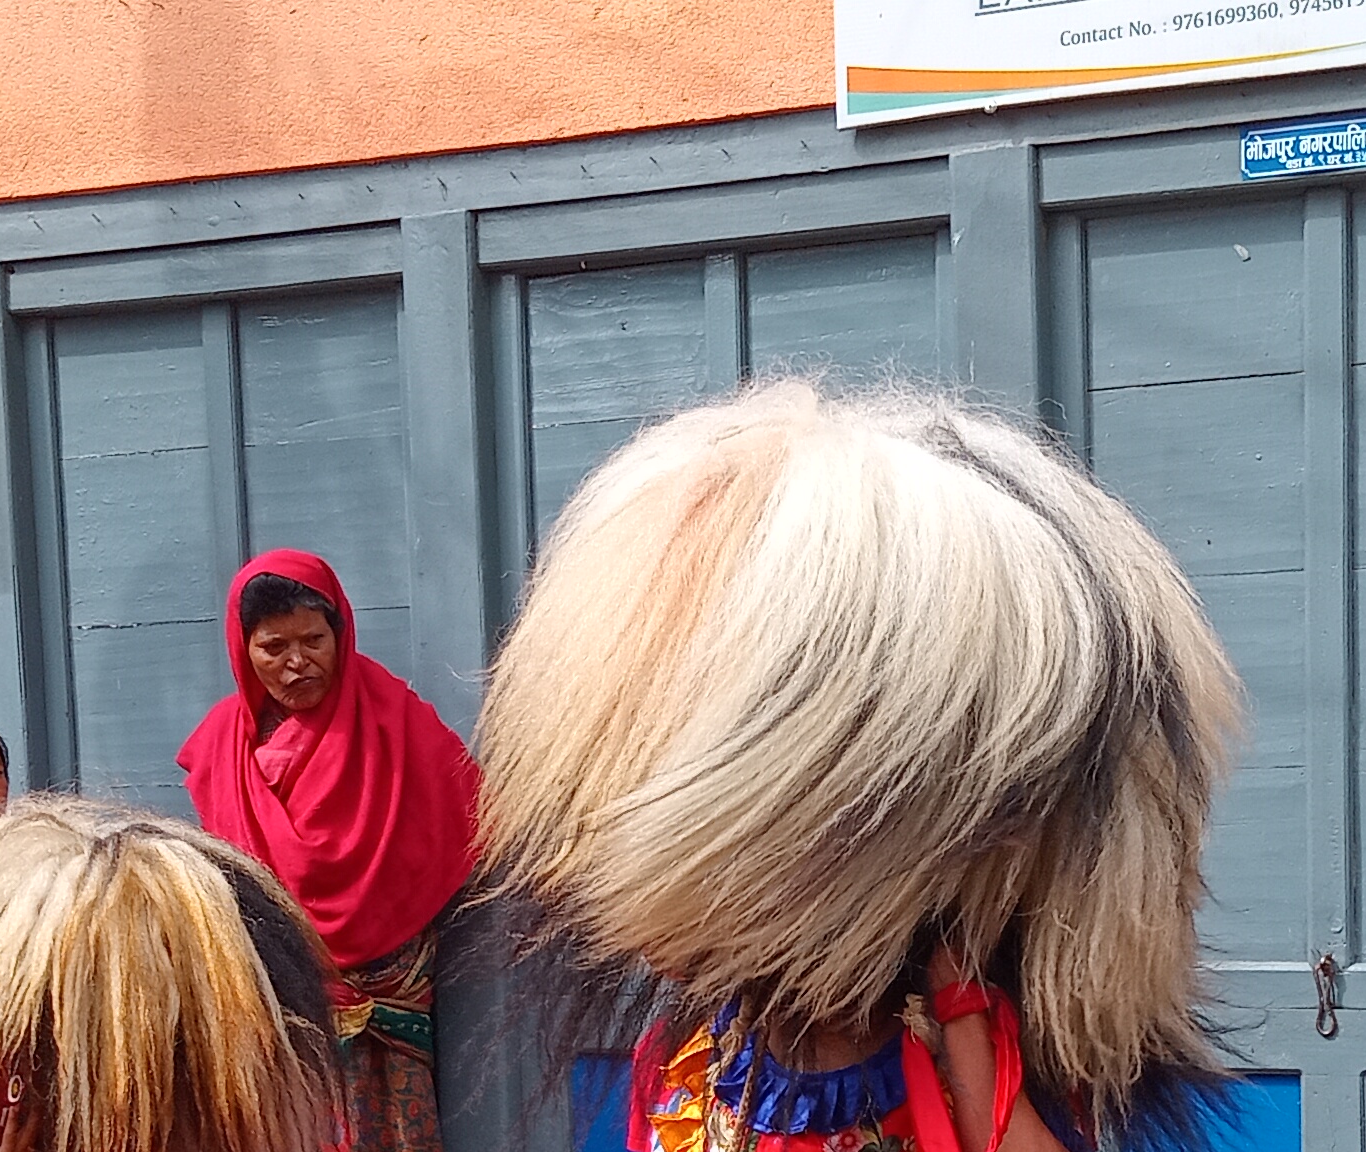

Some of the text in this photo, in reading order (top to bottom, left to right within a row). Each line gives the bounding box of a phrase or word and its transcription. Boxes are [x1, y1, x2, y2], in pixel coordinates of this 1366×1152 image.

[1060, 25, 1123, 46] Contact
[1129, 20, 1157, 37] No.
[1172, 2, 1284, 31] 9761699360,
[1246, 135, 1296, 163] भोजपुर
